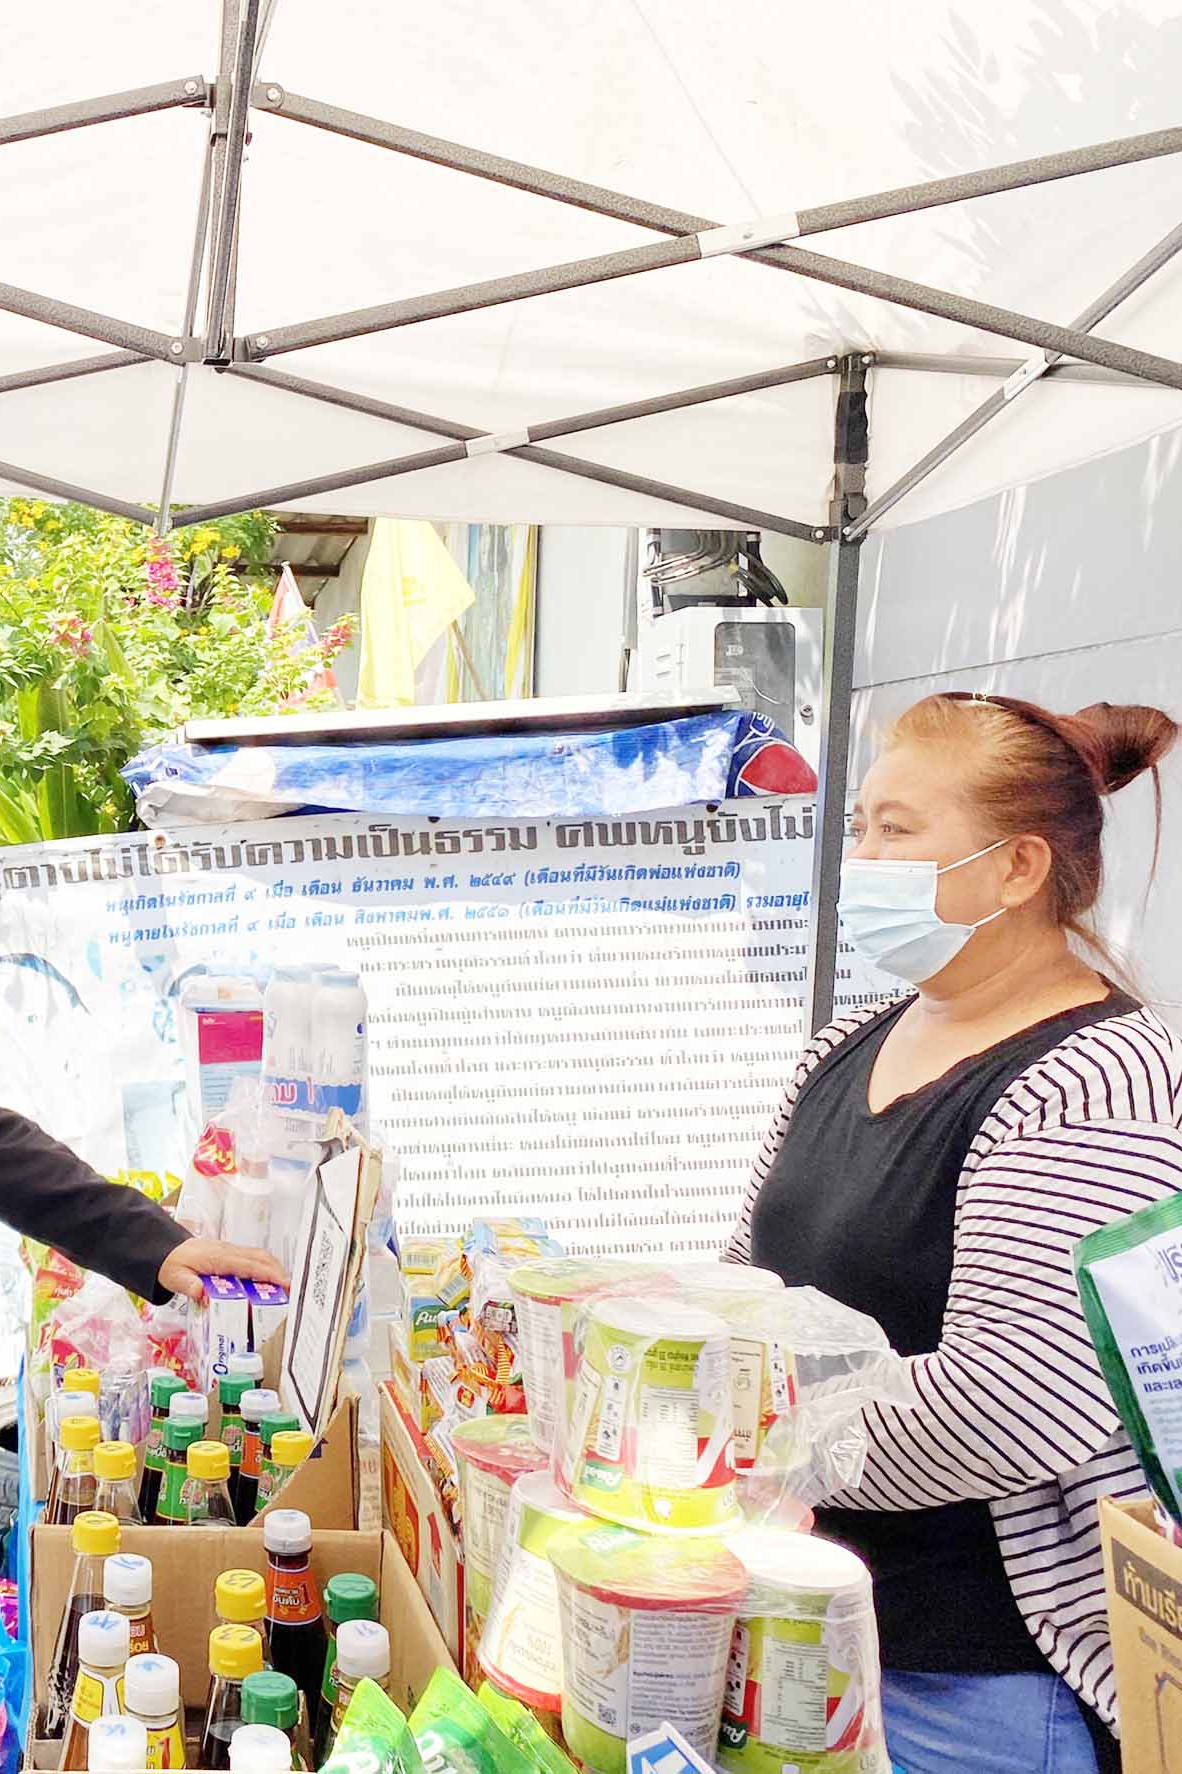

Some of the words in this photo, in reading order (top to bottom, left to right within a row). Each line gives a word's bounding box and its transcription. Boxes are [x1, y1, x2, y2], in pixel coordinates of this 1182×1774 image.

[302, 877, 343, 897] เดือน
[352, 875, 414, 894] ธันวาคม
[212, 1334, 228, 1375] Original
